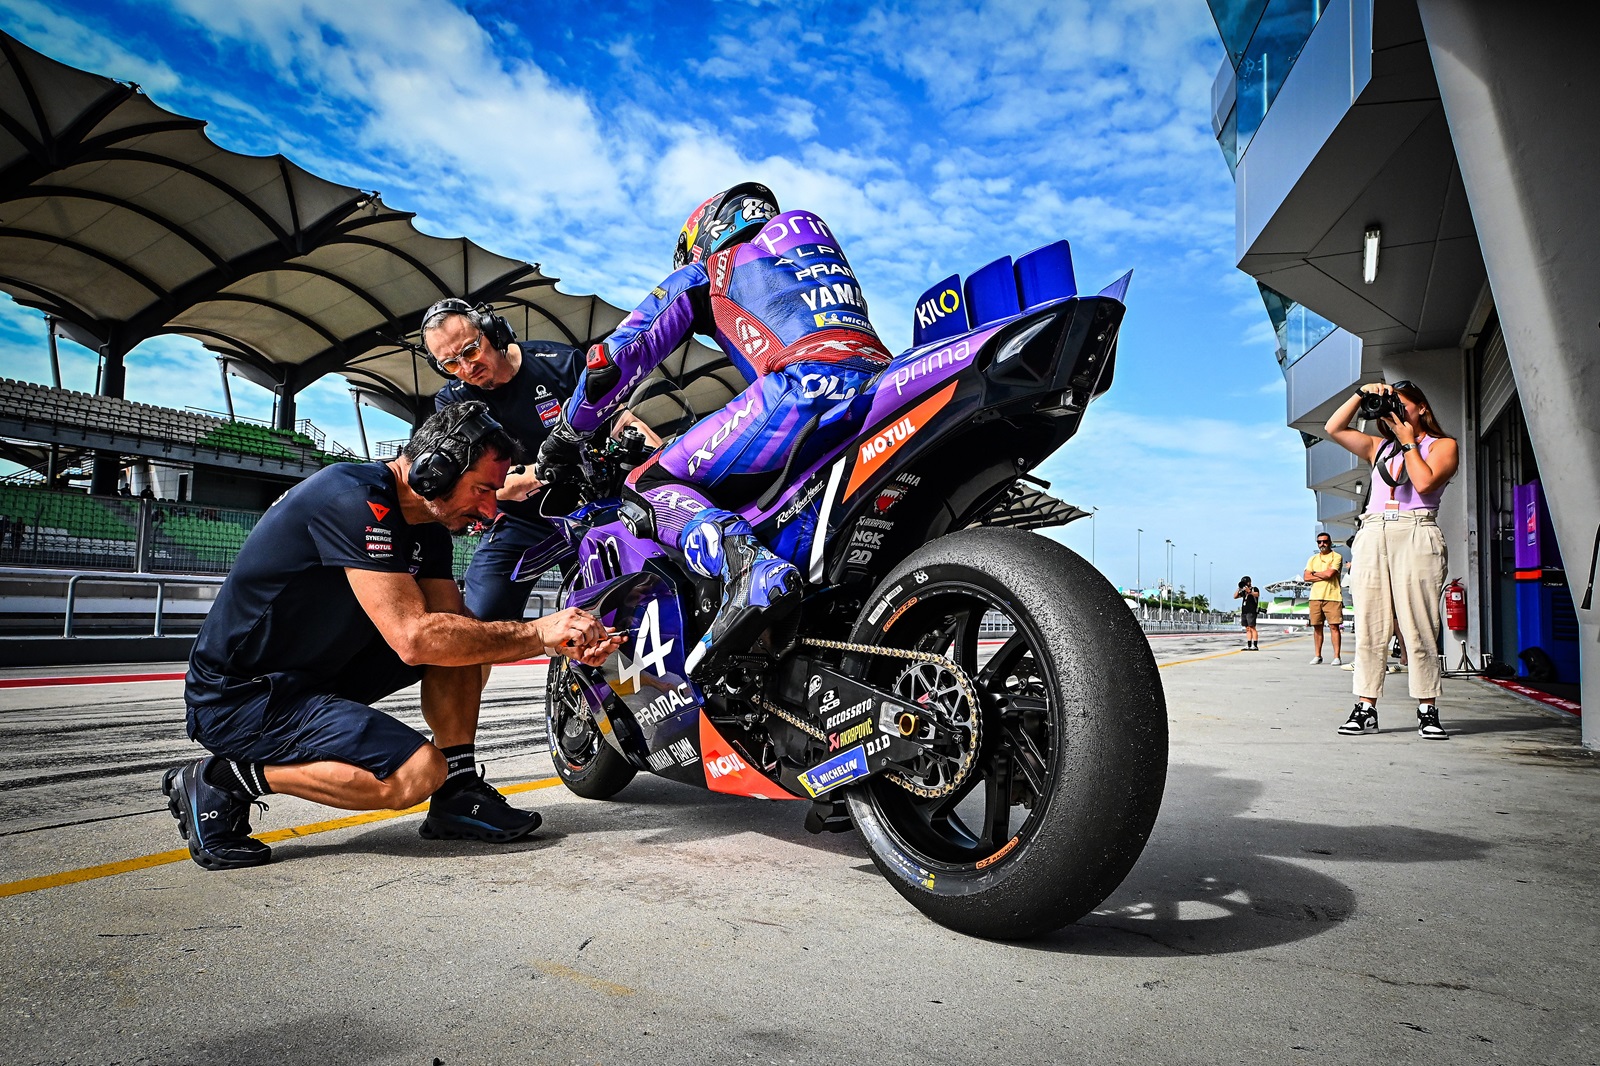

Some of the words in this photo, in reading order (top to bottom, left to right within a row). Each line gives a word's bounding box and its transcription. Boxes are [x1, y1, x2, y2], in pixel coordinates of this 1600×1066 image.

[916, 289, 960, 329] KILO
[891, 341, 971, 396] prima
[687, 399, 755, 477] IXON
[861, 417, 915, 465] MOTUL
[775, 504, 796, 529] Revs
[794, 494, 809, 515] Your
[807, 480, 823, 499] Heart
[851, 530, 885, 546] NGK
[847, 549, 873, 565] 2D
[635, 682, 694, 730] PRAMAC
[819, 698, 840, 714] RCB
[826, 698, 872, 730] ACCOSSATO
[668, 737, 697, 763] FIAMM
[866, 734, 891, 756] D.I.D
[819, 758, 858, 784] MICHELIN
